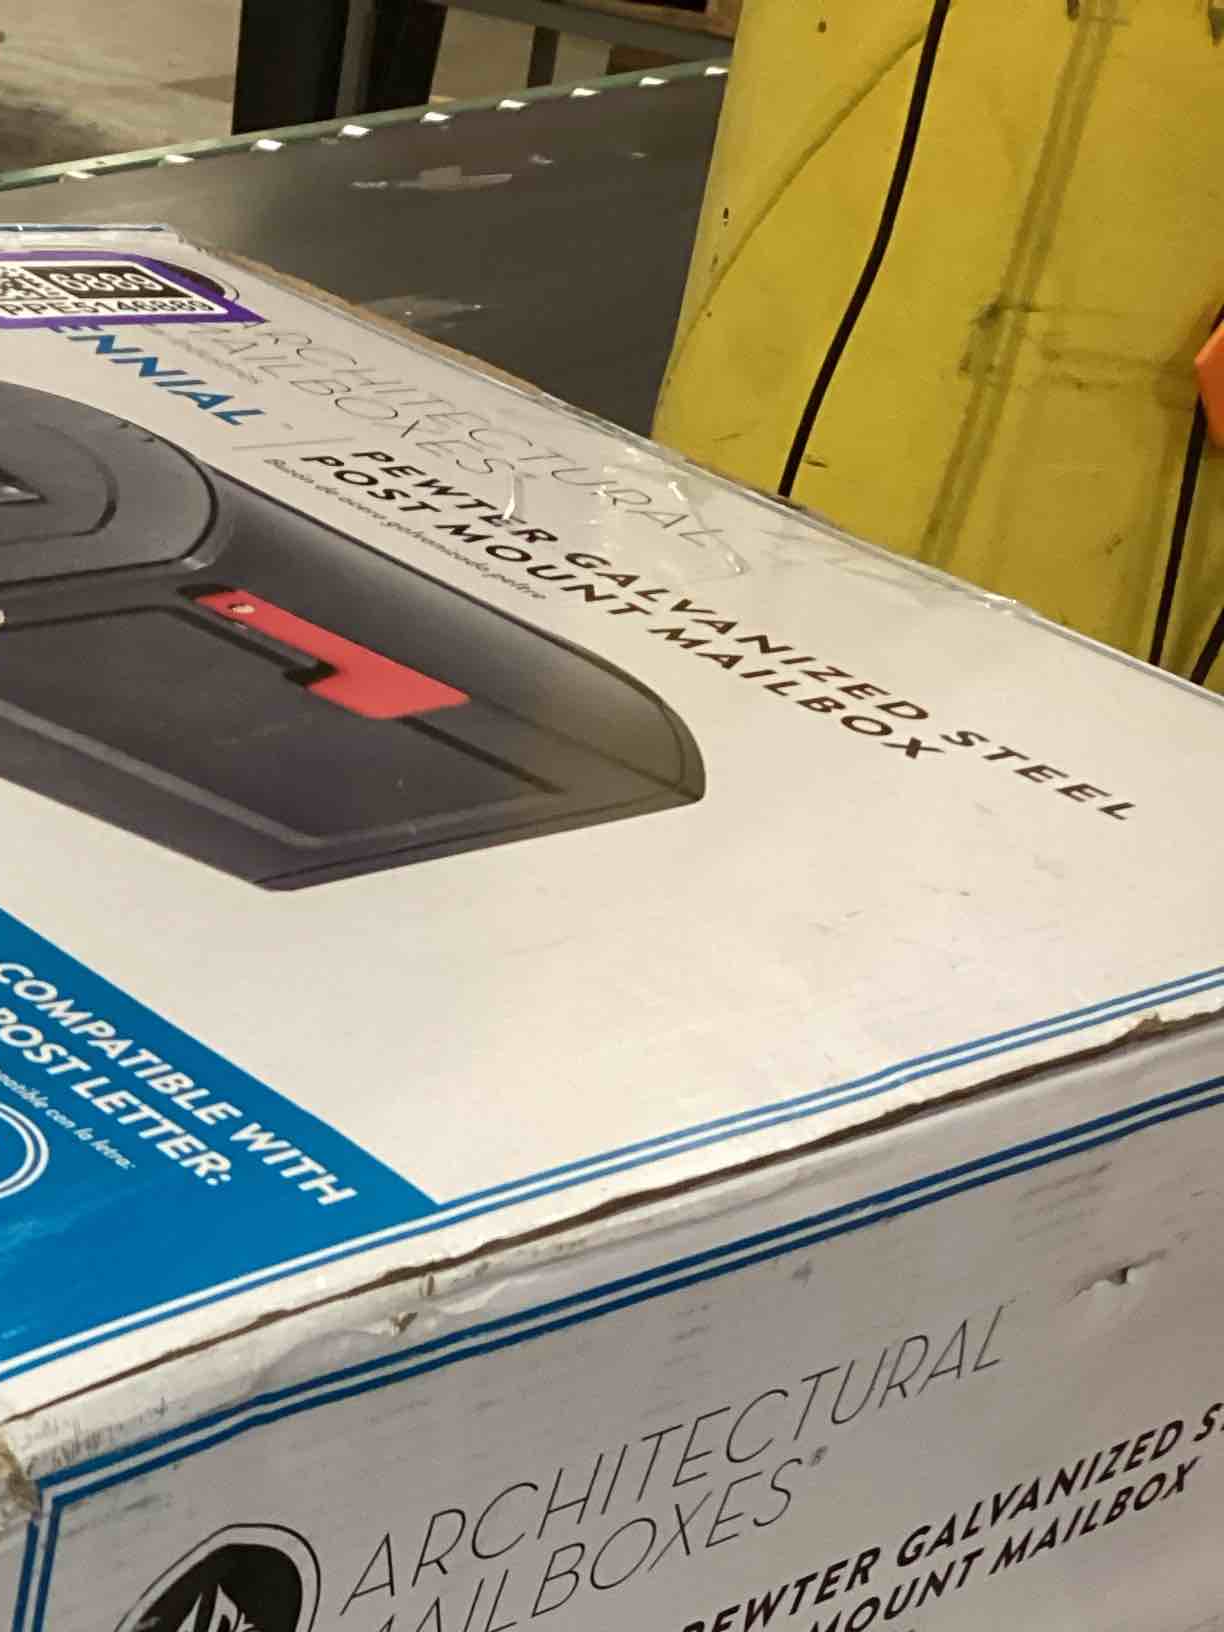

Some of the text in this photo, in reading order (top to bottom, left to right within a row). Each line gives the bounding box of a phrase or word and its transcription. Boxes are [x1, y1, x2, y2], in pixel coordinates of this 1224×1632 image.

[51, 267, 163, 298] 6889
[300, 455, 947, 760] POST MOUNT MAILBOX
[351, 451, 1136, 820] PEWTER GALVANIZED STEEL
[69, 1076, 233, 1187] LETTER:
[235, 1119, 359, 1207] WITH
[340, 1303, 1007, 1616] ARCHITECTURAL
[895, 1419, 1184, 1570] GALVANIZED
[1193, 1402, 1224, 1442] S
[990, 1456, 1202, 1576] MAILBOX
